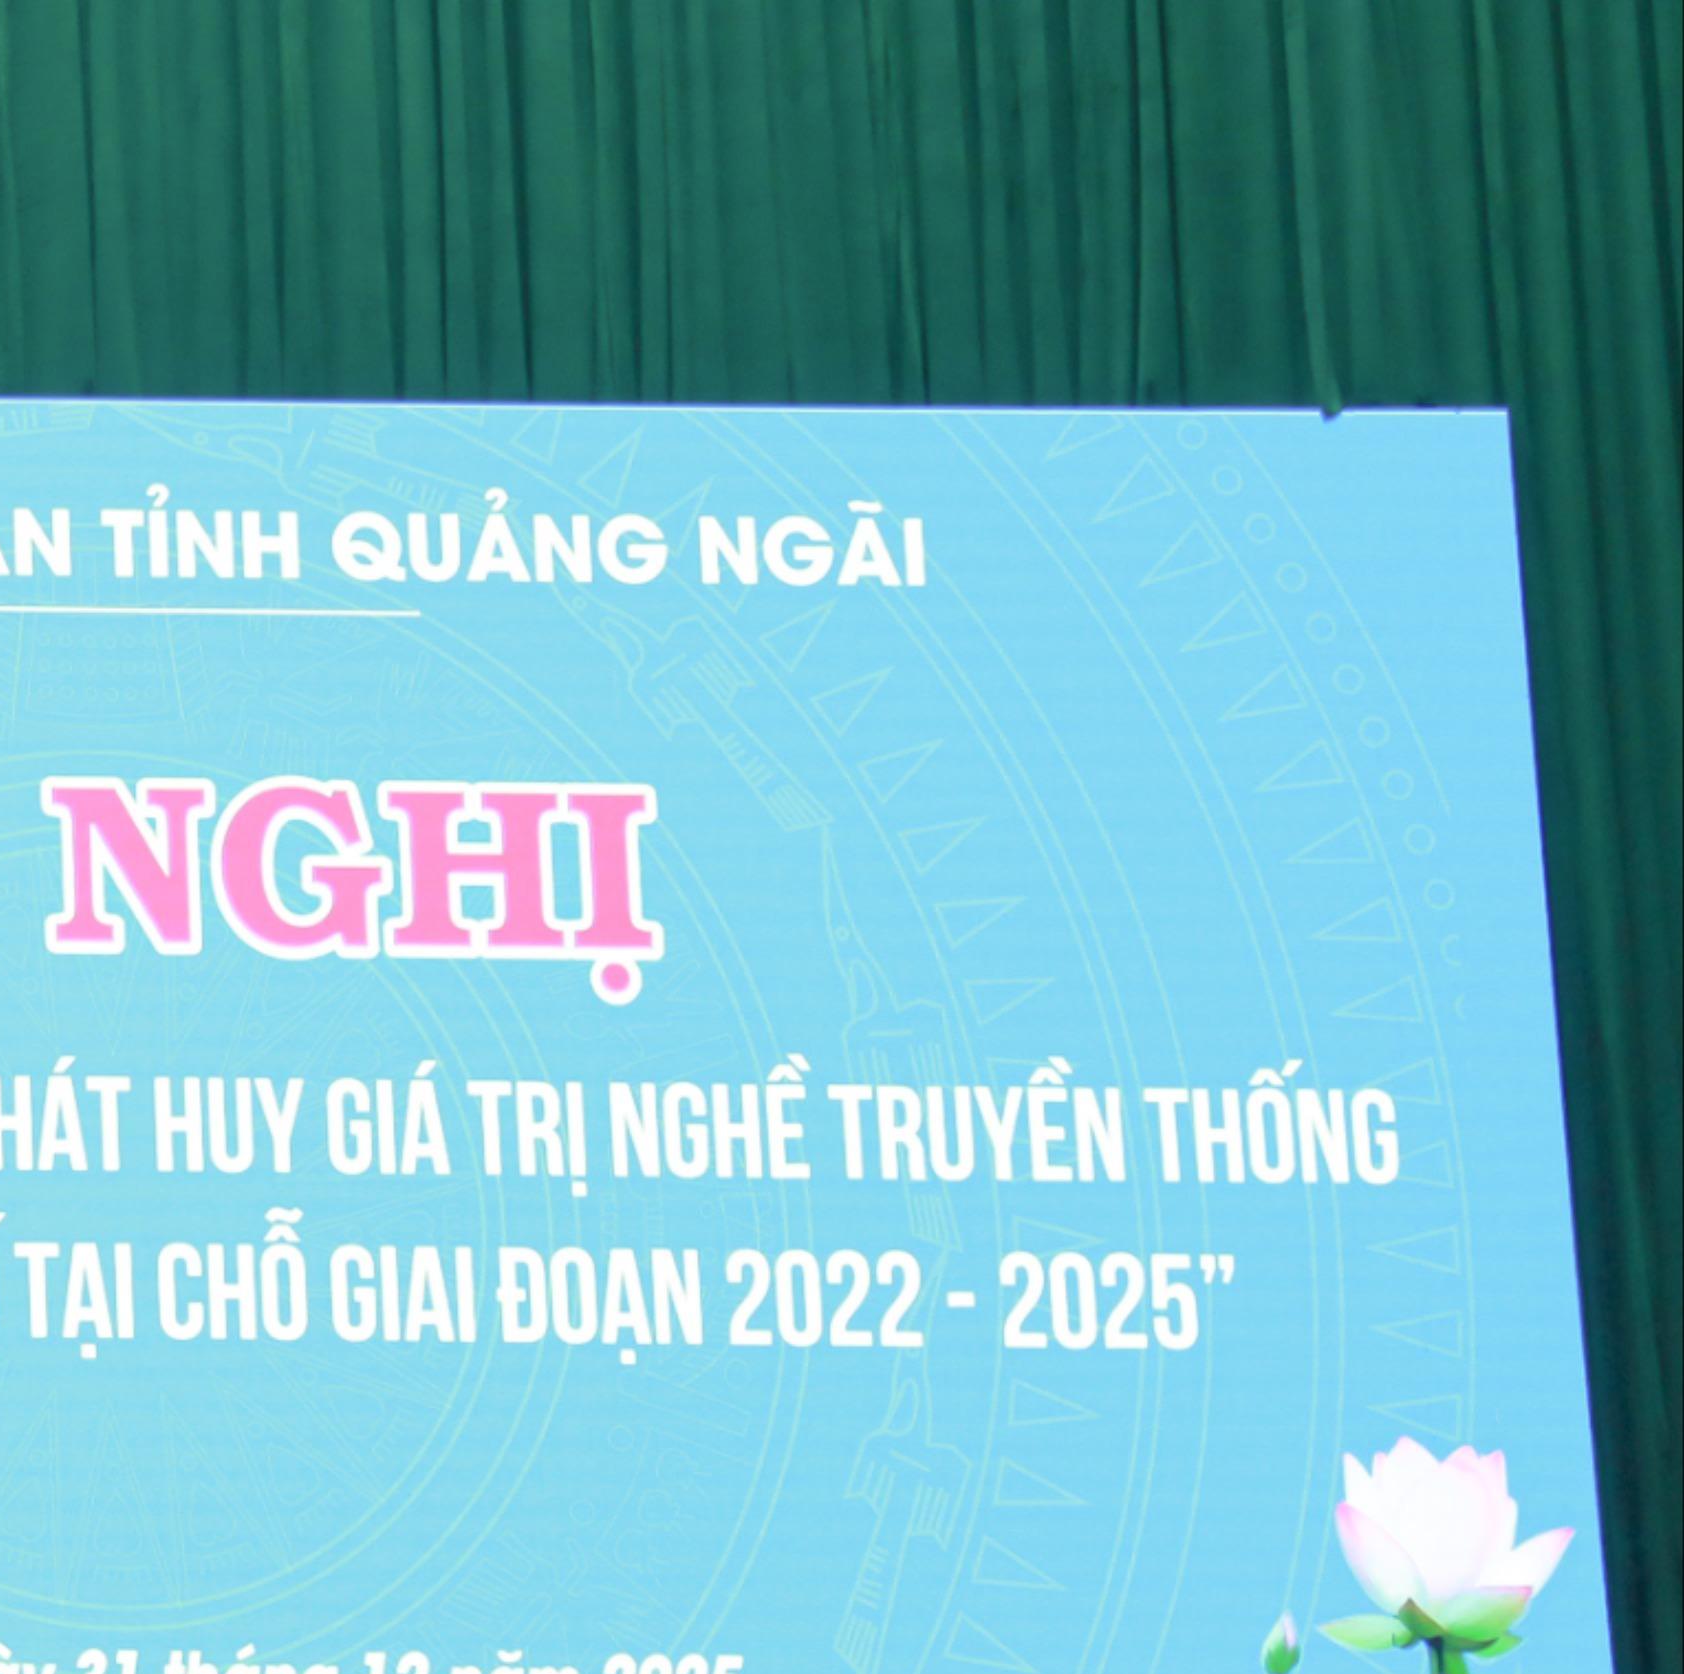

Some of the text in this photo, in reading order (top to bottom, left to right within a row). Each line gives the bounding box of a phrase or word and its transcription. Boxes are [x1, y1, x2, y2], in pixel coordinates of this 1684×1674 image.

[100, 483, 301, 580] TỈNH
[330, 487, 669, 585] QUẢNG
[698, 500, 926, 587] NGÃI
[39, 774, 666, 1006] NGHỊ
[153, 1076, 305, 1174] HUY
[326, 1059, 451, 1176] GIÁ
[466, 1080, 588, 1198] TRỊ
[608, 1053, 812, 1180] NGHỀ
[827, 1056, 1126, 1182] TRUYỀN
[1142, 1058, 1400, 1185] THỐNG
[13, 1241, 135, 1360] TẠI
[157, 1206, 309, 1342] CHỖ
[329, 1243, 477, 1344] GIAI
[495, 1246, 704, 1366] ĐOẠN
[725, 1248, 924, 1348] 2022
[946, 1291, 976, 1308] -
[998, 1250, 1235, 1350] 2025”
